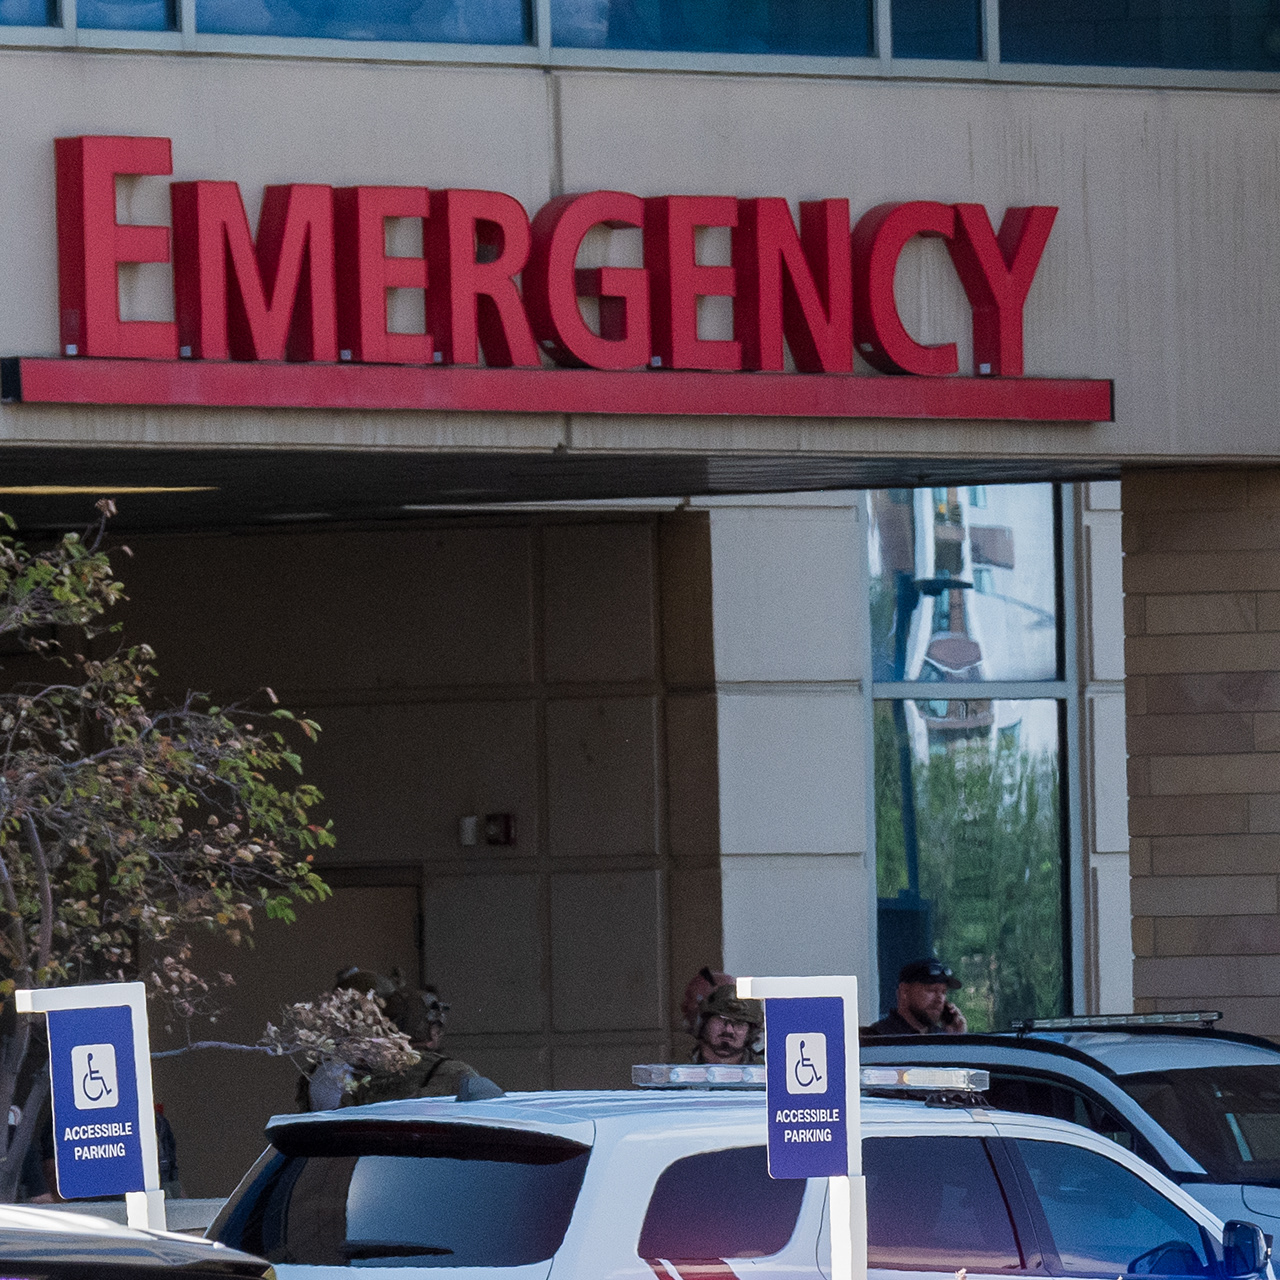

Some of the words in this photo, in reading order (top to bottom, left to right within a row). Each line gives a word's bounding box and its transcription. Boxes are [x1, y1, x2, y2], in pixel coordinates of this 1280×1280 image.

[54, 136, 1059, 377] EMERGENCY
[775, 1108, 840, 1123] ACCESSIBLE
[63, 1122, 133, 1141] ACCESSIBLE
[784, 1128, 832, 1143] PARKING
[74, 1142, 126, 1160] PARKING
